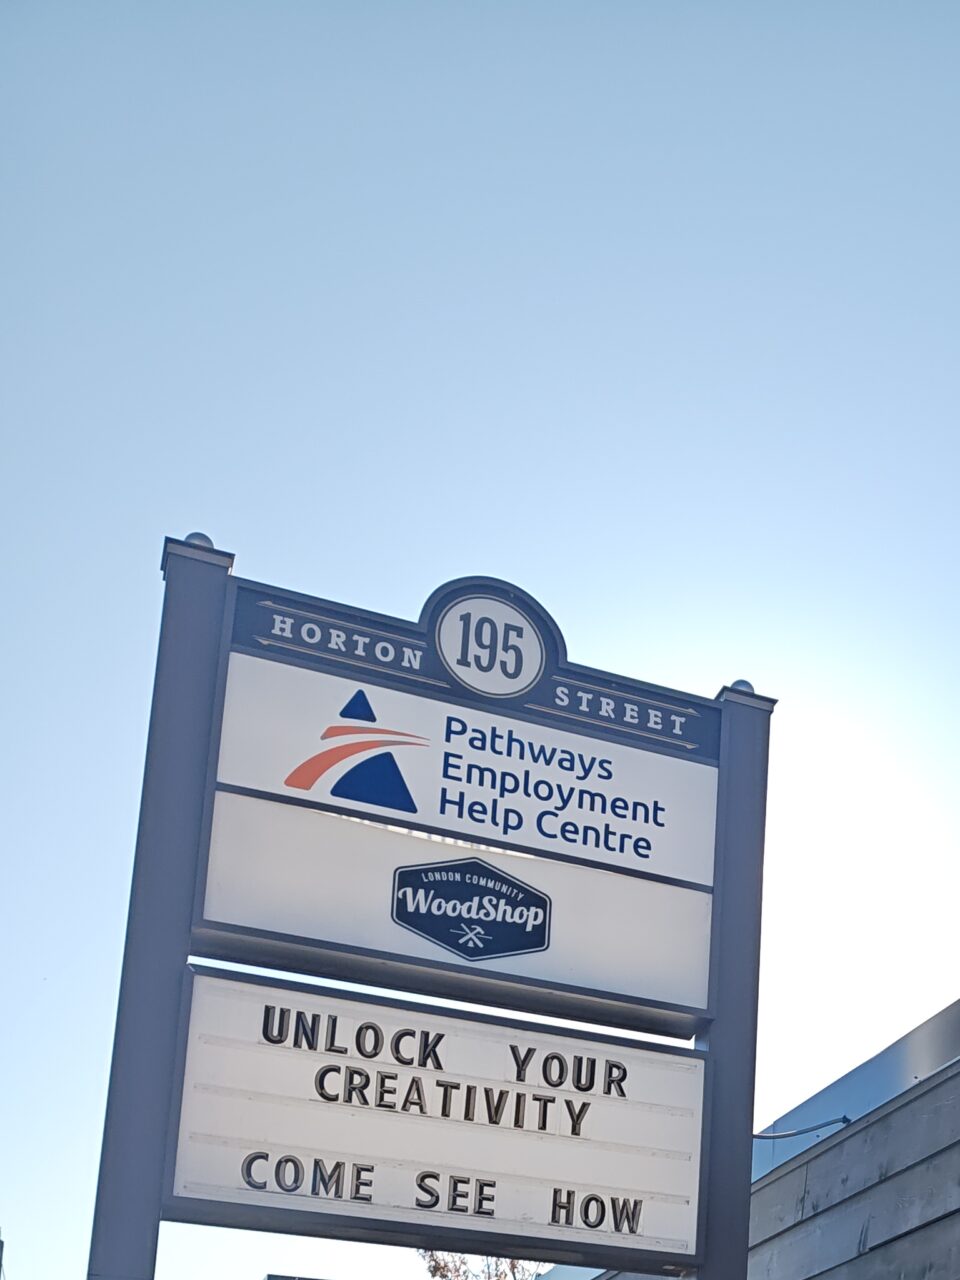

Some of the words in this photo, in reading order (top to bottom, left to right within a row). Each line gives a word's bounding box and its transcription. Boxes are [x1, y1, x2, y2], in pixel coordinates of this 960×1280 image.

[272, 614, 423, 671] HORTON
[455, 612, 524, 680] 195
[554, 686, 686, 736] STREET
[444, 716, 613, 781] Pathways
[440, 787, 524, 835] Help
[536, 811, 652, 859] Centre
[441, 753, 666, 828] Employment
[398, 886, 544, 932] WoodShop
[421, 871, 461, 882] LONDON
[465, 874, 525, 901] COMMUNITY
[261, 1004, 444, 1070] UNLOCK
[510, 1044, 629, 1098] YOUR
[314, 1064, 591, 1136] CREATIVITY
[240, 1151, 374, 1202] COME
[415, 1171, 497, 1217] SEE
[551, 1188, 643, 1235] HOW
